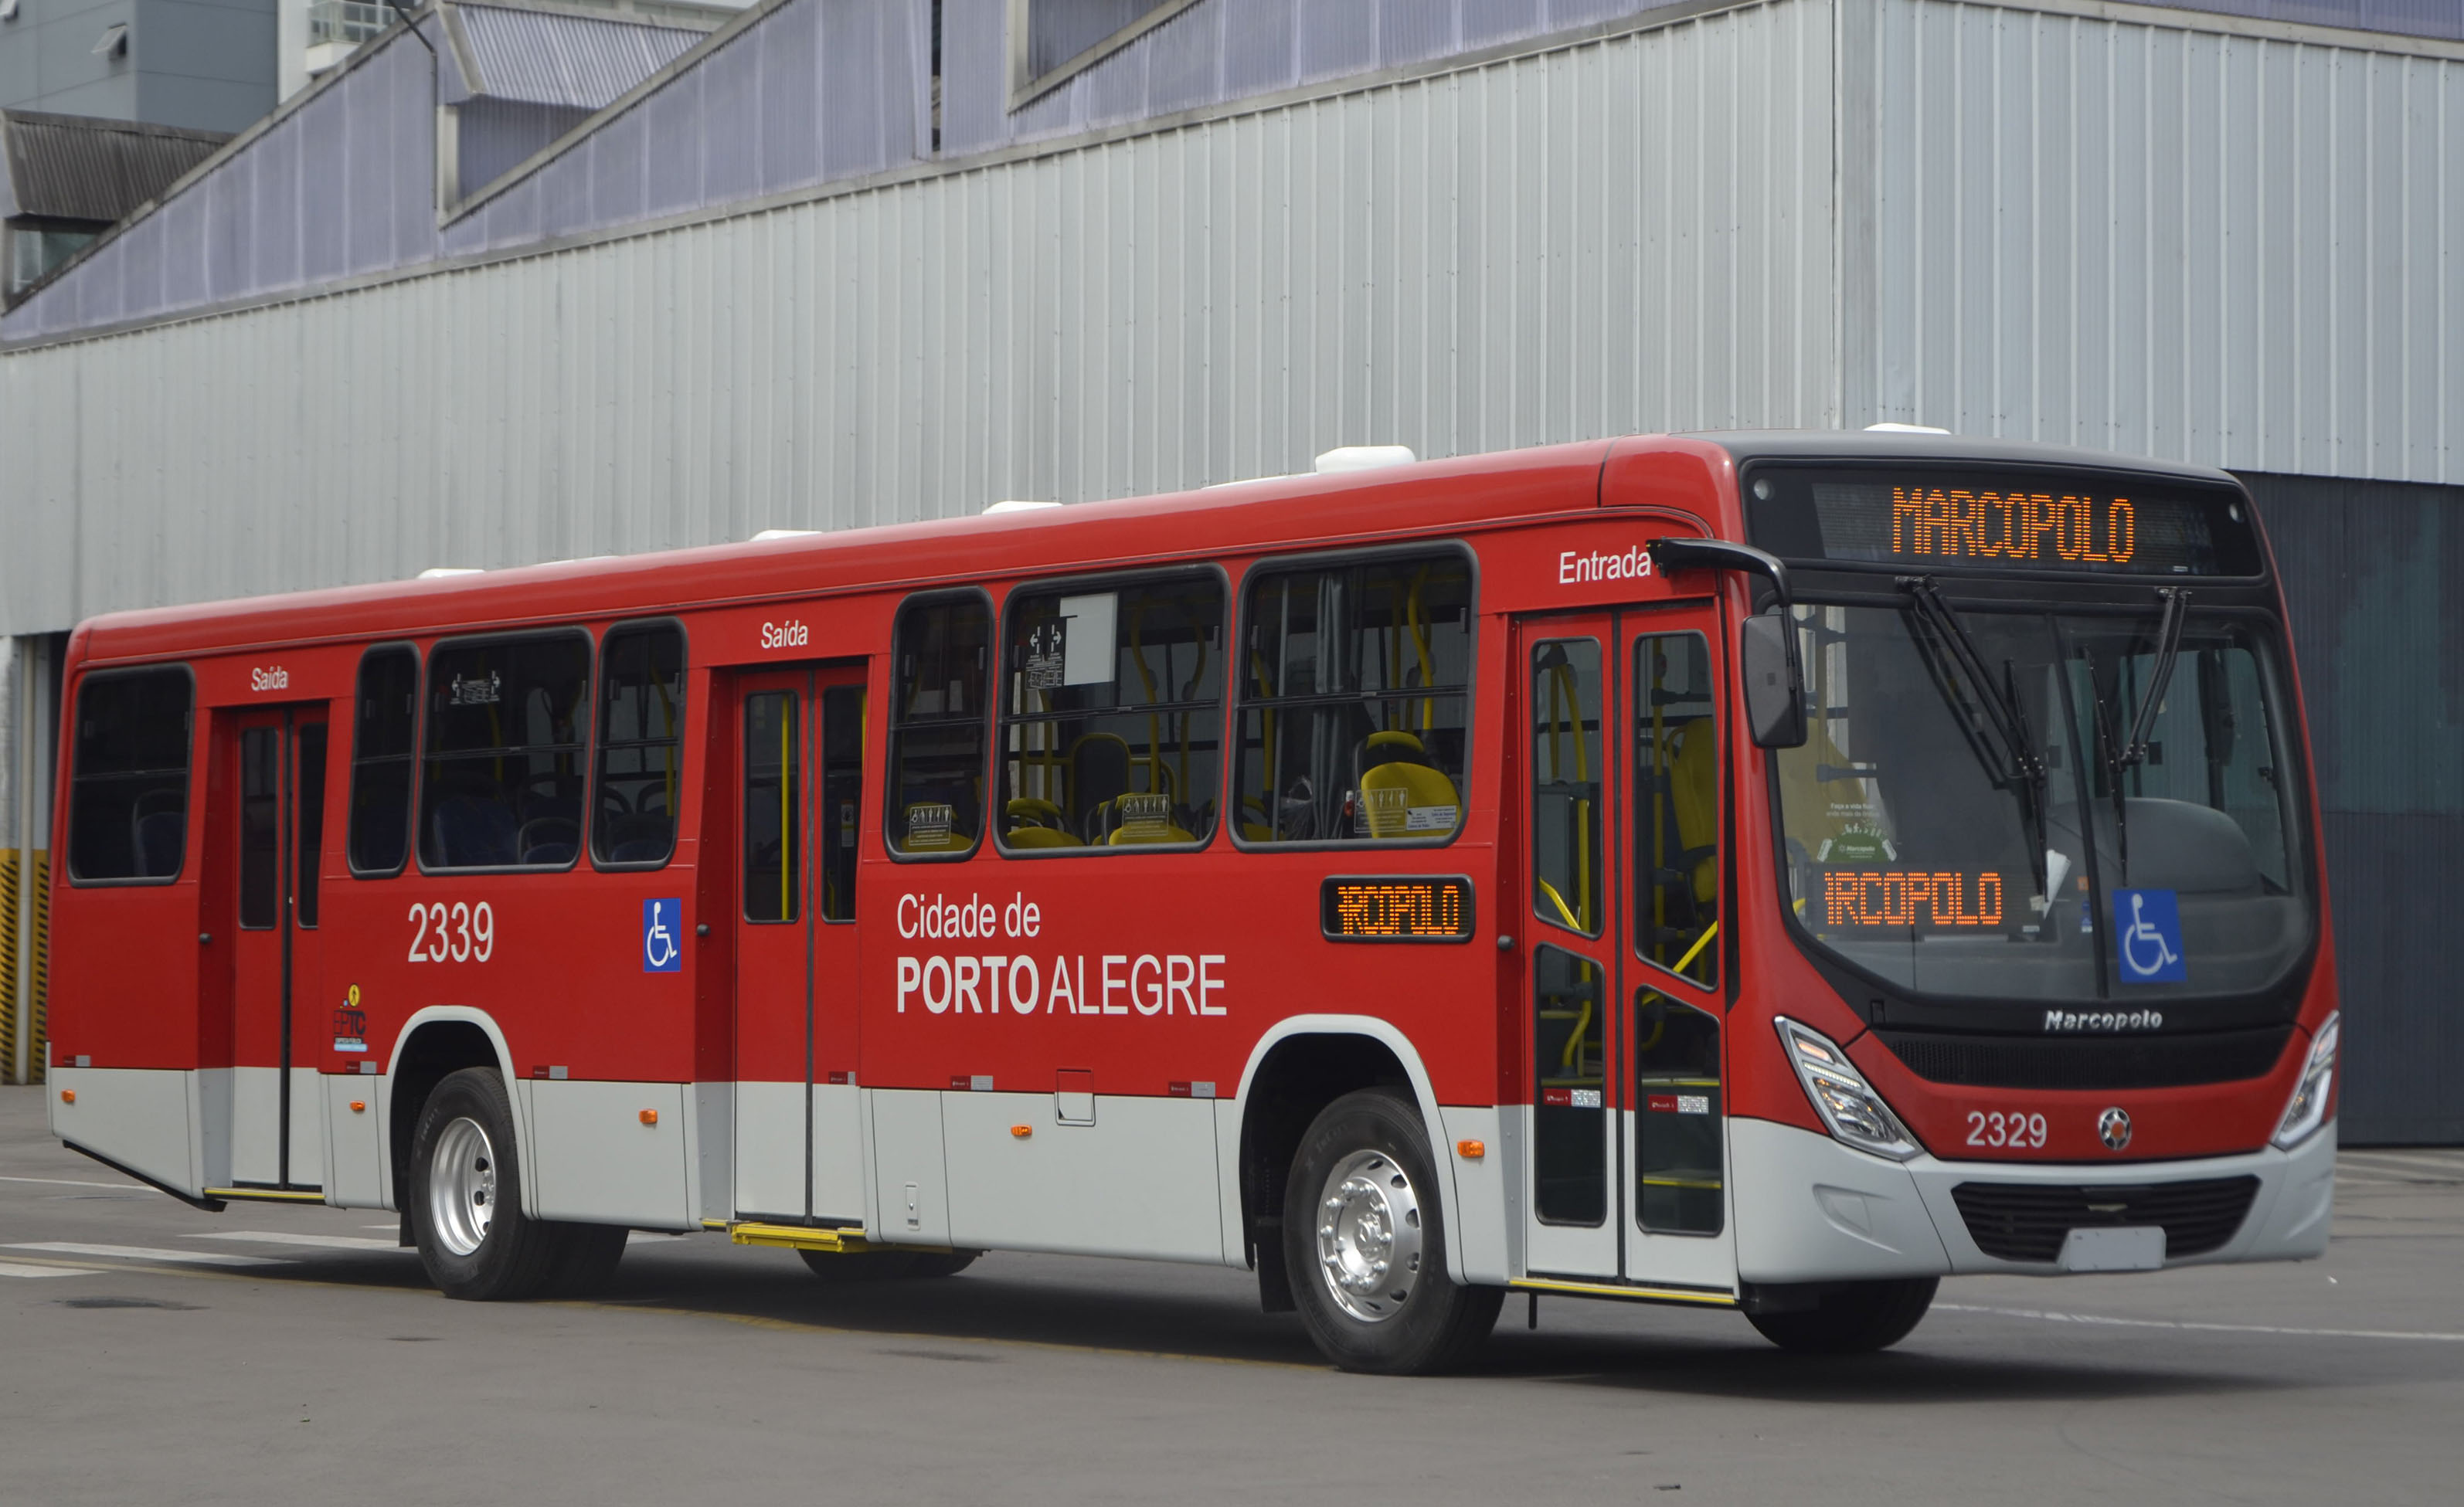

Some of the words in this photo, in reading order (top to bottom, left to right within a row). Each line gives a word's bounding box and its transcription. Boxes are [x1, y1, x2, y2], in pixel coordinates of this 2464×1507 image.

[1892, 487, 2134, 563] MARCOPOLO
[1558, 545, 1652, 584] Entrada
[760, 619, 809, 650] Saída
[251, 665, 289, 691] Saída
[407, 901, 494, 963] 2339
[897, 892, 997, 939] Cidade
[1004, 891, 1041, 938] de
[897, 954, 1040, 1015] PORTO
[1046, 953, 1228, 1016] ALEGRE
[333, 1010, 366, 1036] EPTC
[2044, 1009, 2163, 1031] Marcopolo
[1966, 1111, 2047, 1148] 2329
